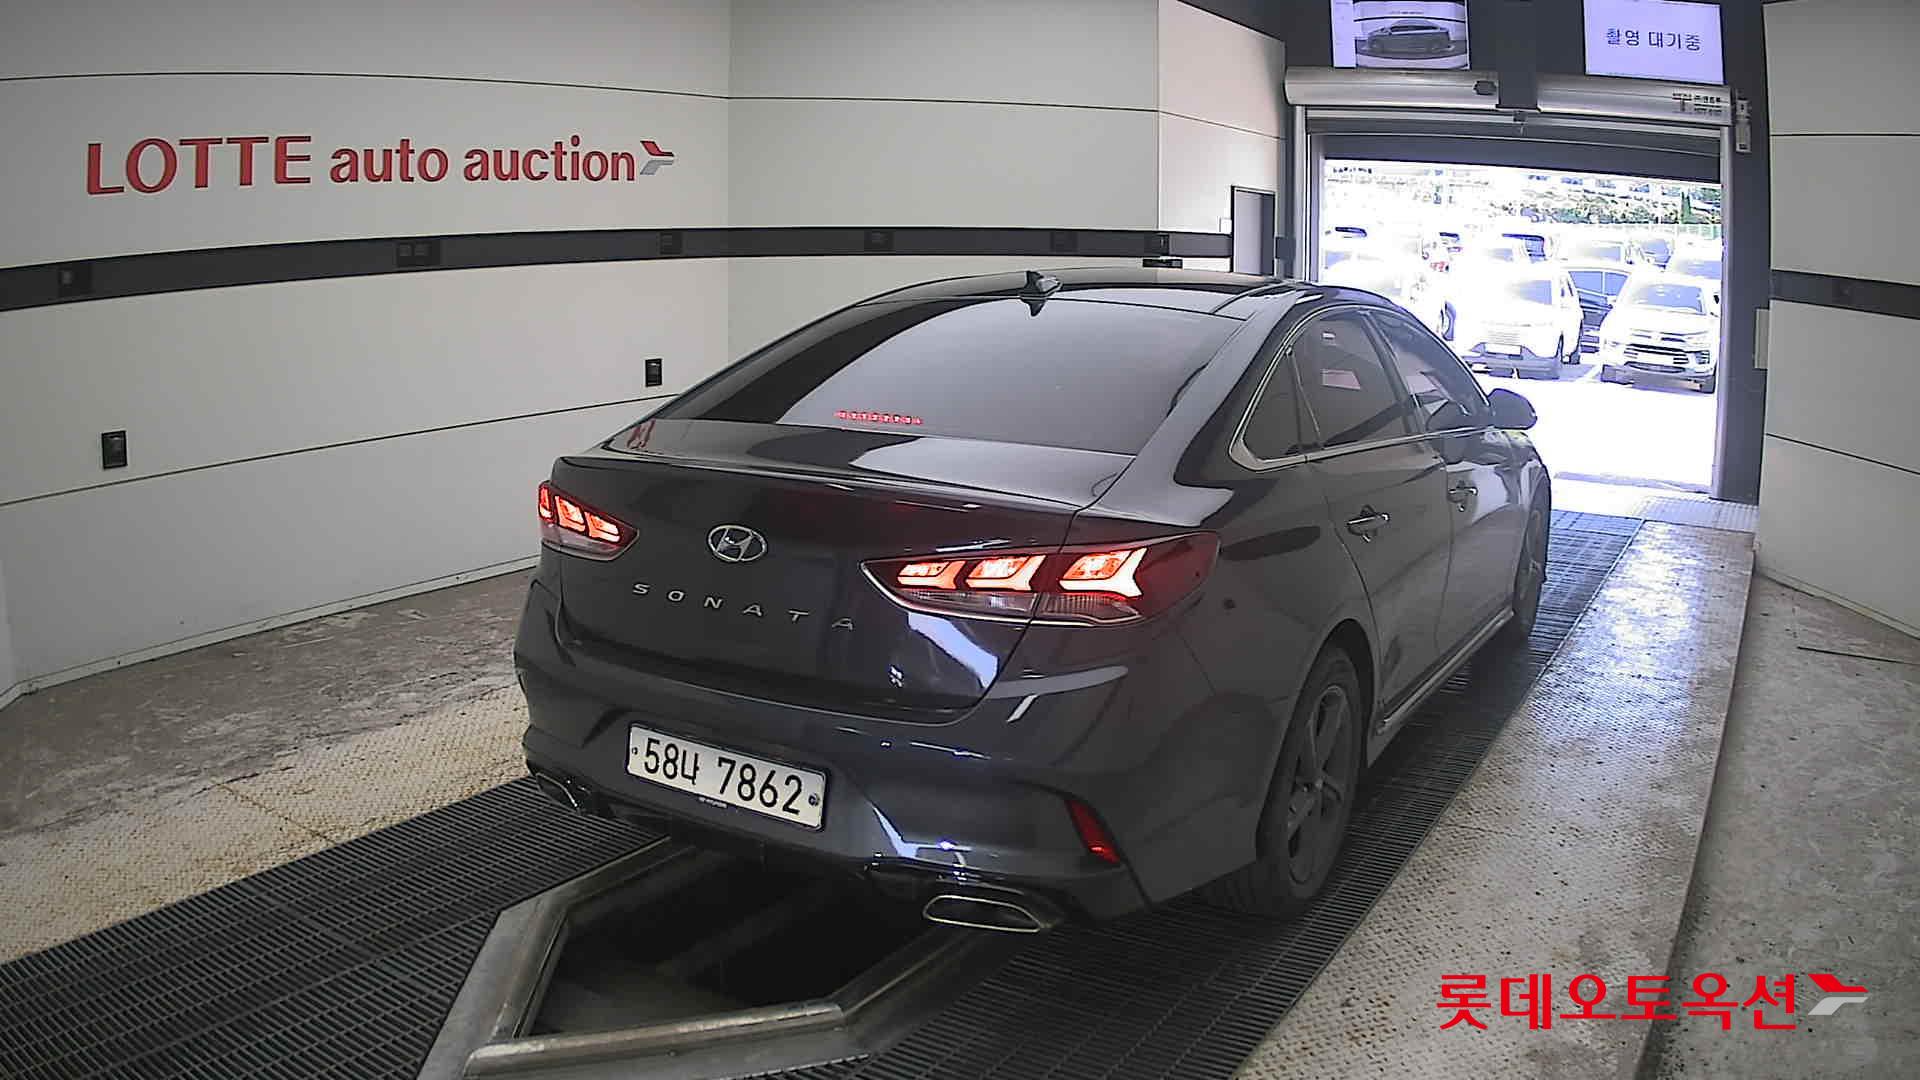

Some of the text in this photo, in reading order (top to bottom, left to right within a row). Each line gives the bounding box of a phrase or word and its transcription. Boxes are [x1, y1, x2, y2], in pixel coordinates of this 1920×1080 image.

[1606, 27, 1701, 52] 촬영 대기중
[86, 134, 635, 195] LOTTE auto auction
[632, 581, 855, 631] SONATA
[643, 736, 803, 816] 58나 7862
